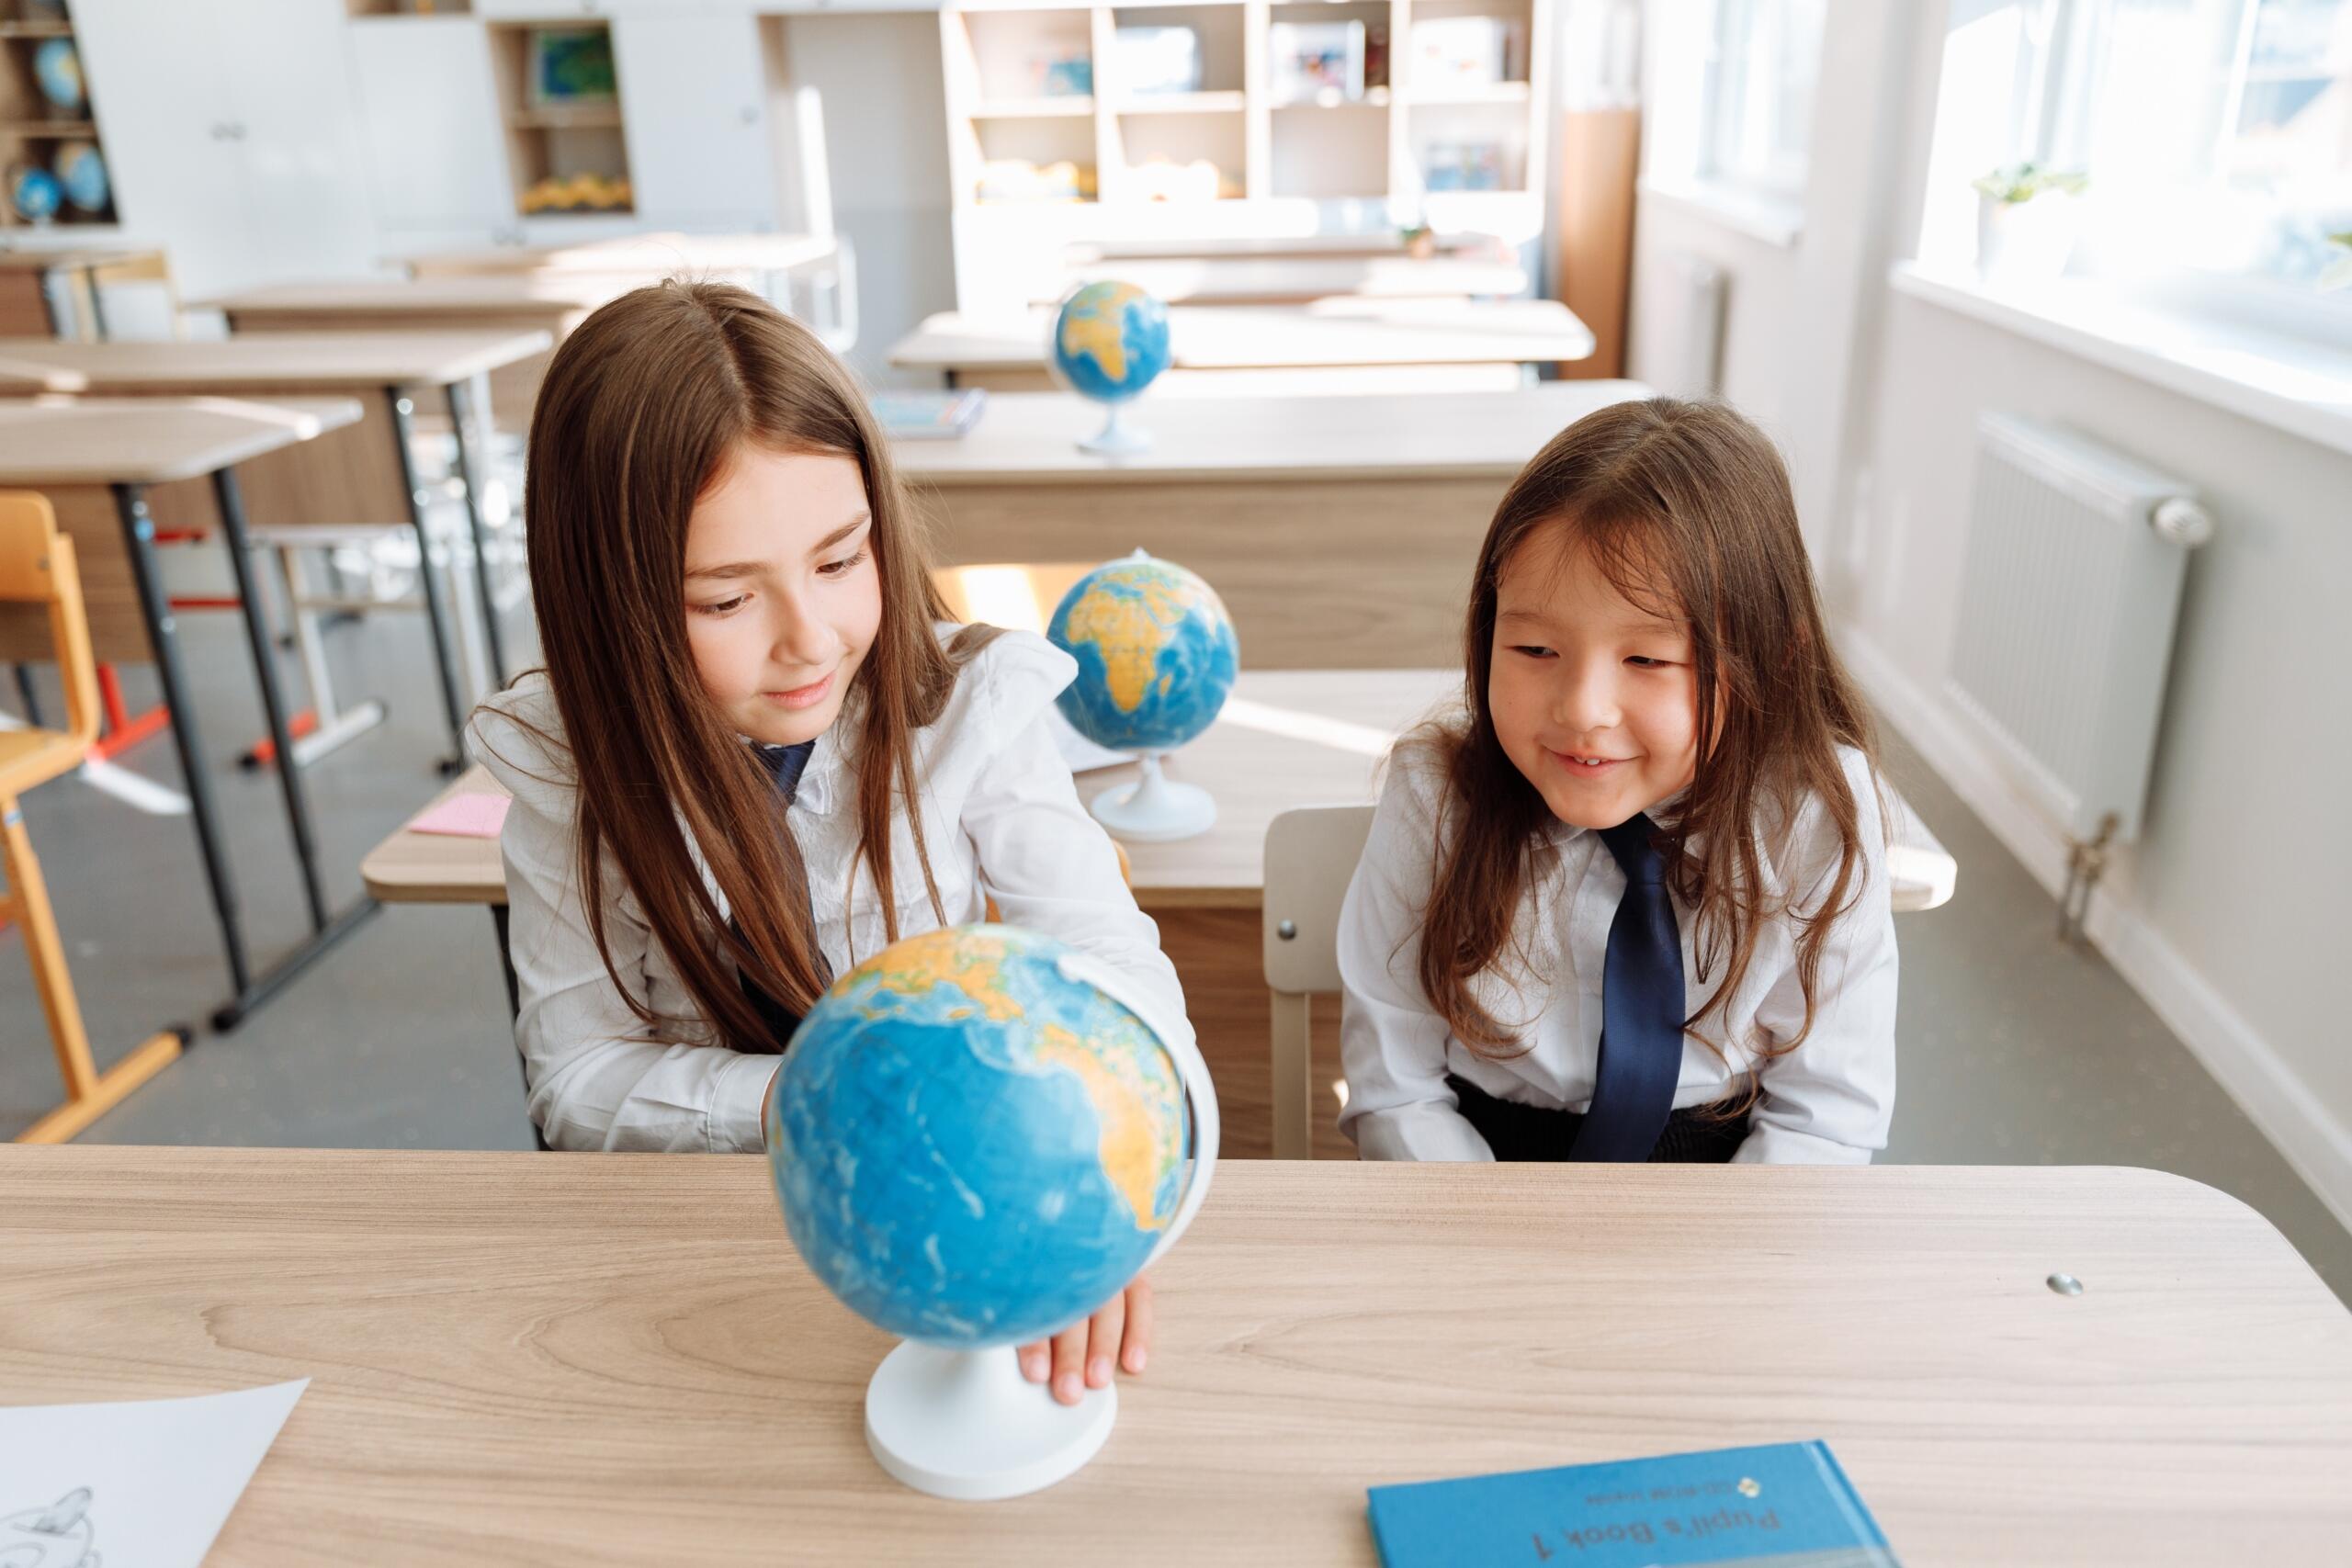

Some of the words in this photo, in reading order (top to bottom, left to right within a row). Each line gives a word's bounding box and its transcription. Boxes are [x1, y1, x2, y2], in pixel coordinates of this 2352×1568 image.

[1564, 1521, 1656, 1550] Book
[1663, 1507, 1781, 1540] Pupil's
[1532, 1532, 1555, 1562] 1
